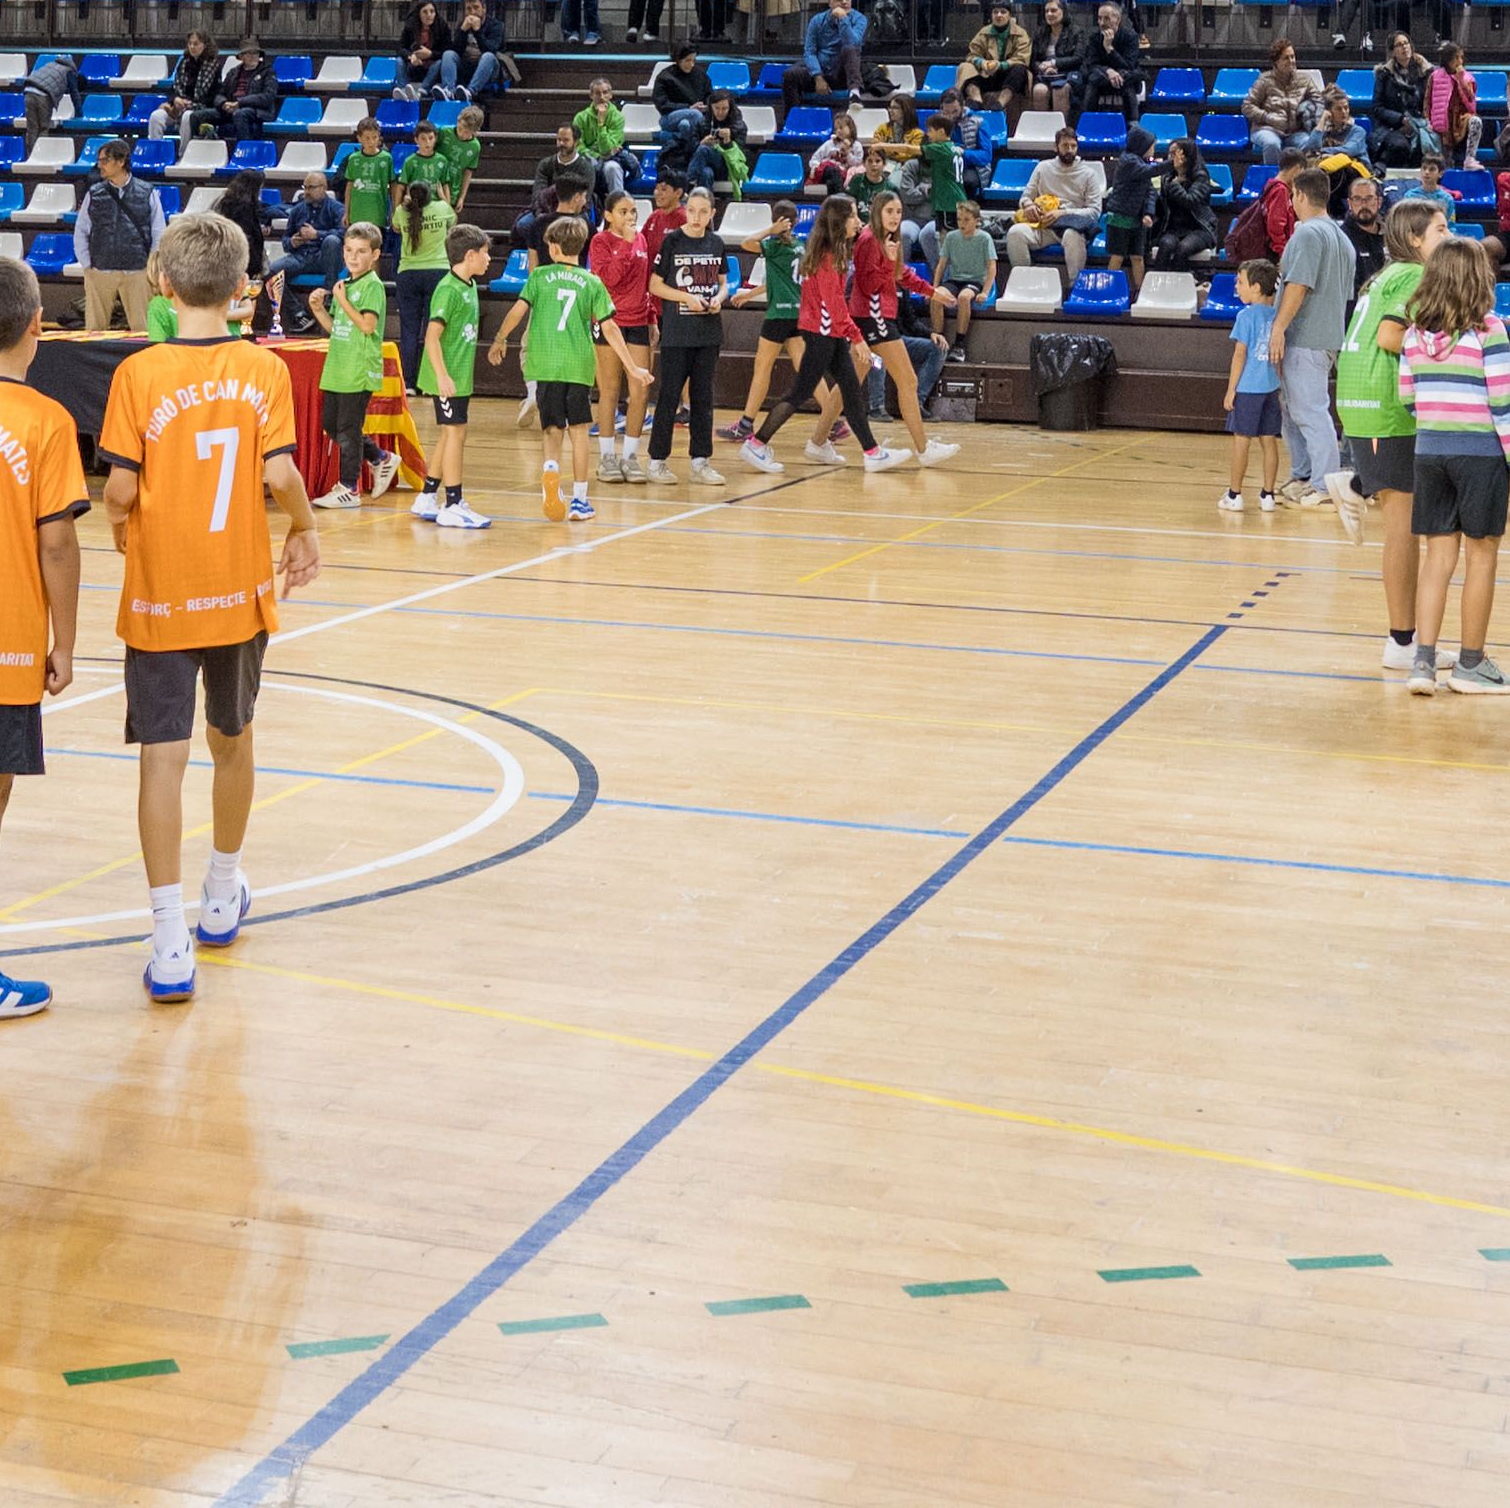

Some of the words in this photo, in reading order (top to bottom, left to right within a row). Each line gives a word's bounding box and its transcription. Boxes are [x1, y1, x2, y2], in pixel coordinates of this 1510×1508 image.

[546, 272, 557, 283] LA
[557, 271, 587, 289] MIRADA
[557, 288, 577, 331] 7
[146, 395, 178, 443] TURÓ
[175, 383, 202, 410] DE
[203, 378, 239, 402] CAN
[195, 426, 240, 533] 7
[132, 597, 172, 617] ESFORÇ
[186, 591, 247, 612] RESPECTE
